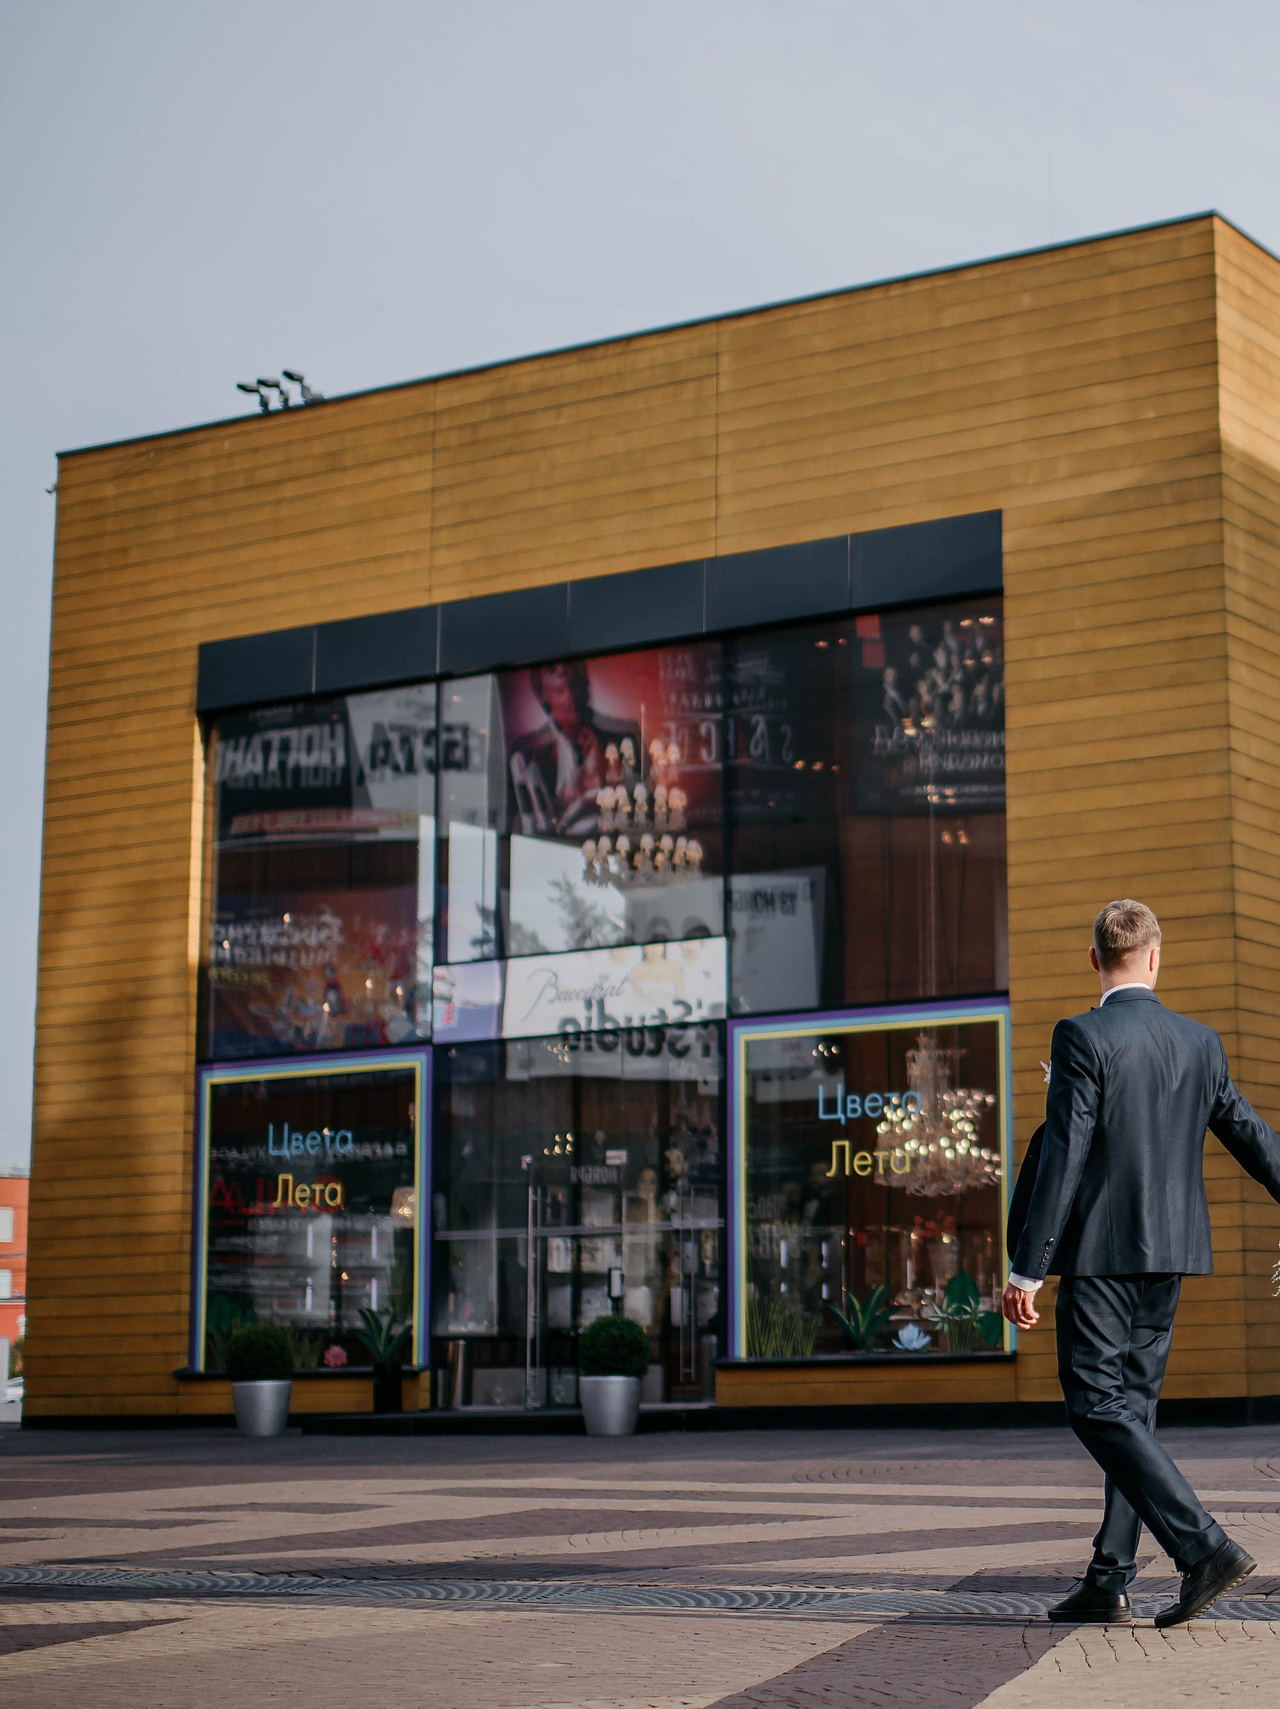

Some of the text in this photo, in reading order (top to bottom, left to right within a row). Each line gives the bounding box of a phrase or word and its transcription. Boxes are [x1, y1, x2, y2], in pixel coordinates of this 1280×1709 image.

[817, 1083, 923, 1125] Цвета
[268, 1122, 353, 1161] Цвета
[825, 1139, 912, 1178] Лета
[271, 1172, 345, 1208] Лета
